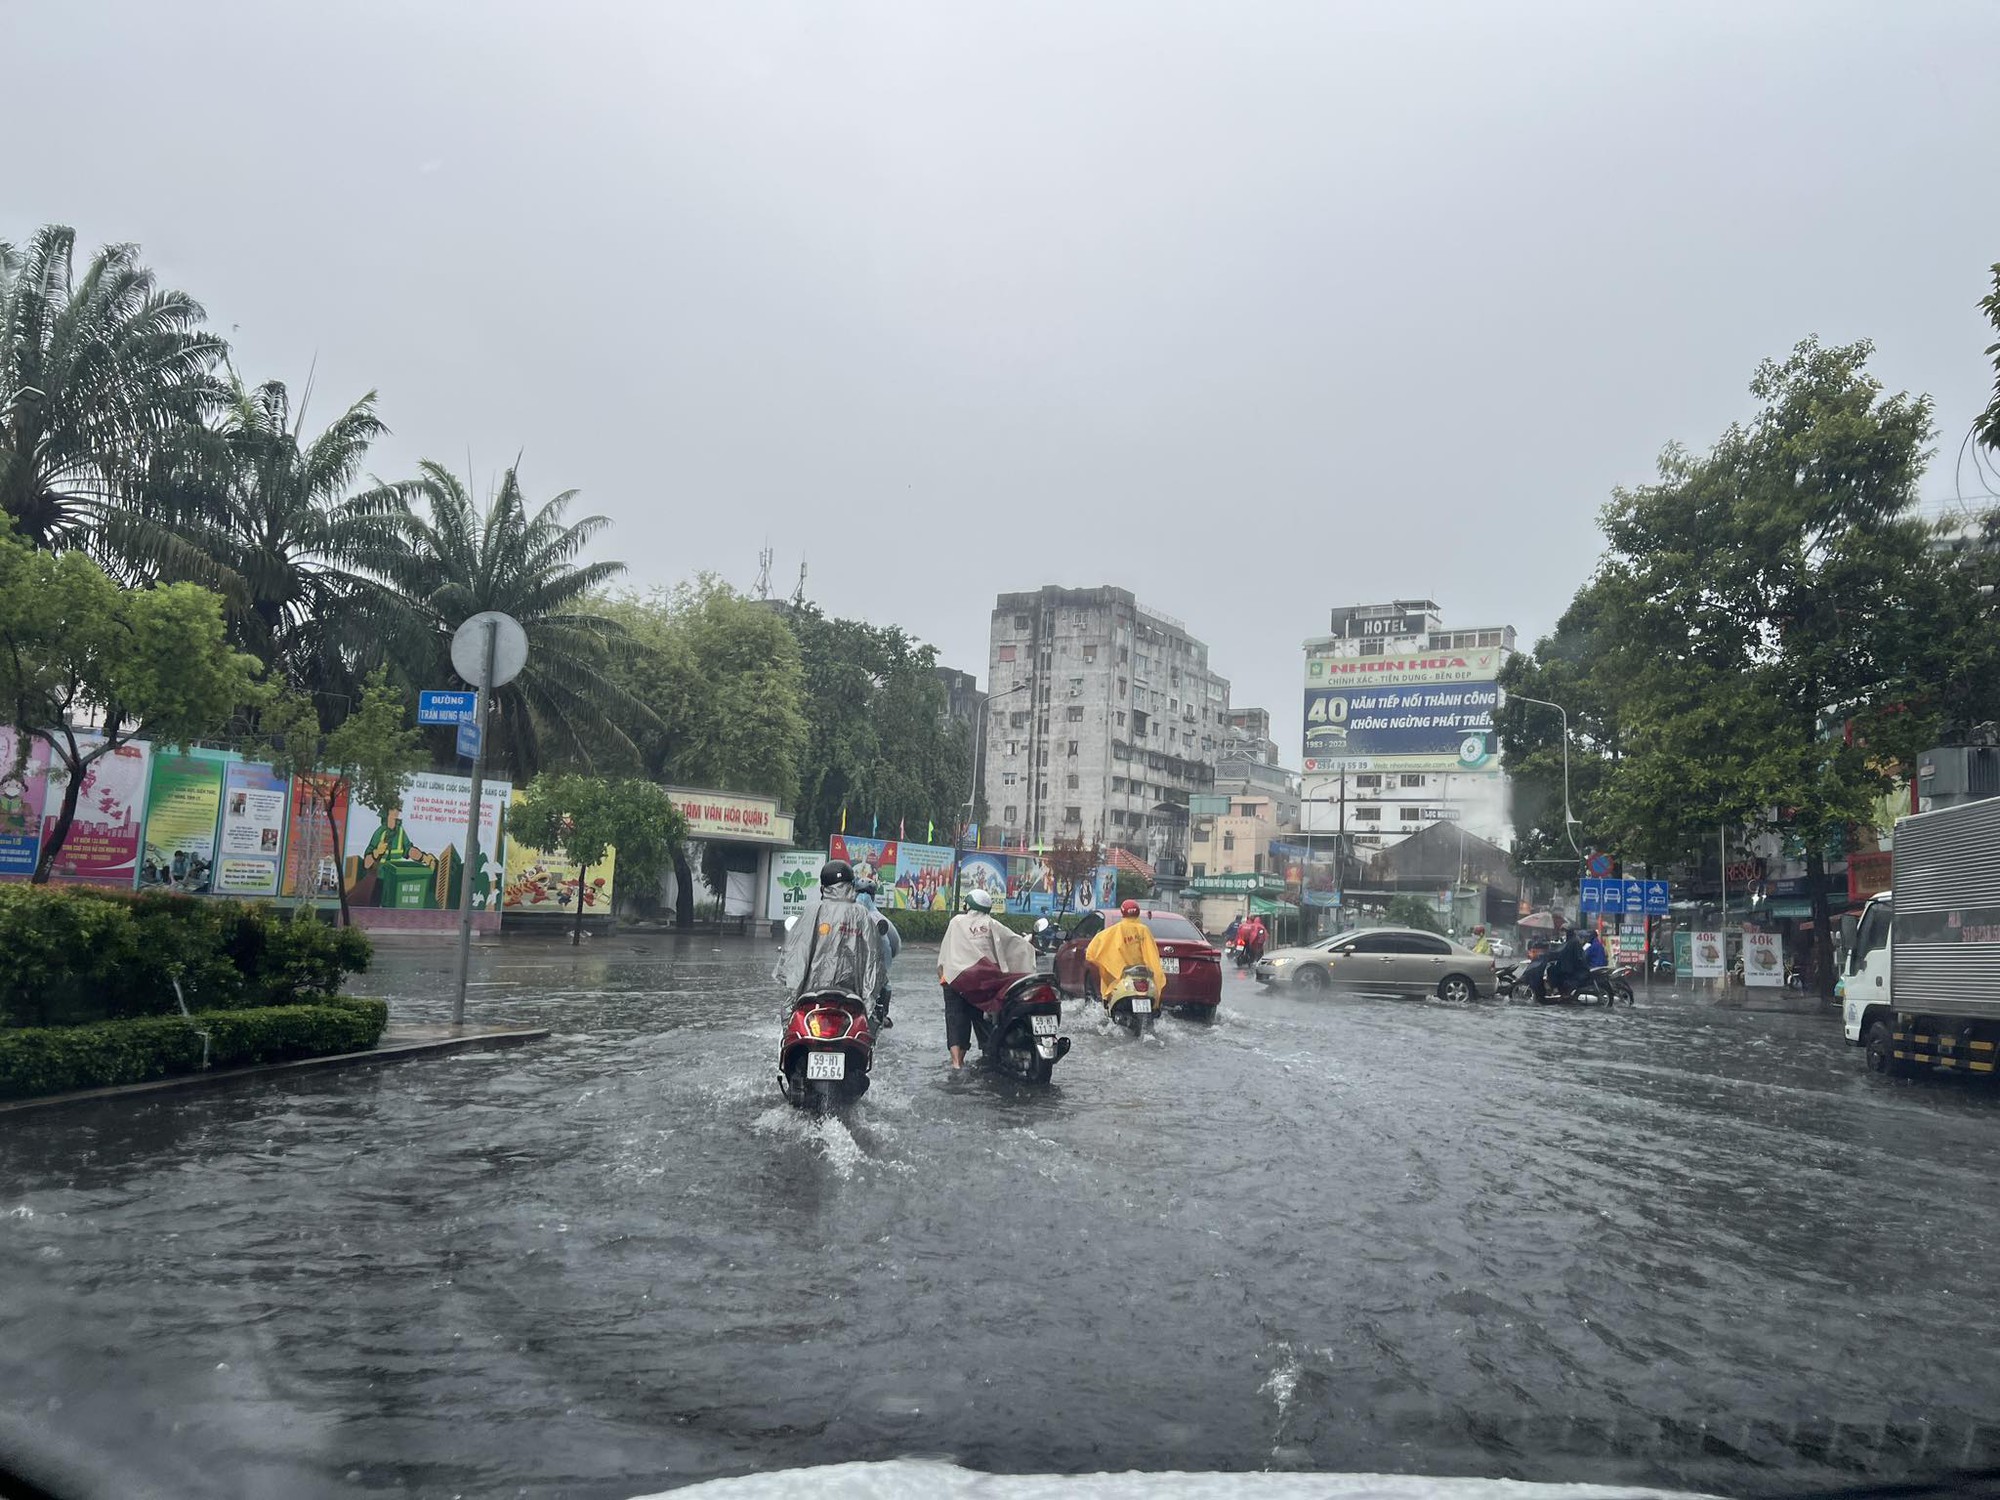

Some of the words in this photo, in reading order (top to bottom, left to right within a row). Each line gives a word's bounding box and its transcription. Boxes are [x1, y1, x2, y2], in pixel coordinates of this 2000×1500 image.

[1364, 620, 1407, 635] HOTEL
[1330, 659, 1404, 674] NHƠN
[1328, 675, 1354, 685] CHÍNH
[1356, 673, 1373, 684] XÁC
[431, 694, 464, 705] ĐƯỜNG
[421, 706, 438, 720] TRẦN
[1308, 696, 1348, 723] 40
[1351, 696, 1375, 709] NĂM
[1377, 693, 1400, 708] TIẾP
[1402, 692, 1422, 707] NỐI
[1424, 691, 1462, 706] THÀNH
[1464, 690, 1496, 704] CÔNG
[1350, 715, 1388, 730] KHÔNG
[1390, 713, 1431, 728] NGỪNG
[1432, 713, 1461, 727] PHÁT
[681, 800, 701, 819] TÂM
[704, 803, 723, 820] VĂN
[724, 805, 741, 823] HÓA
[742, 807, 763, 828] QUẬN
[763, 813, 769, 826] 5
[1696, 933, 1716, 942] 40k
[1750, 935, 1773, 946] 40k
[814, 1054, 838, 1066] 59-H1
[811, 1066, 842, 1078] 175.64
